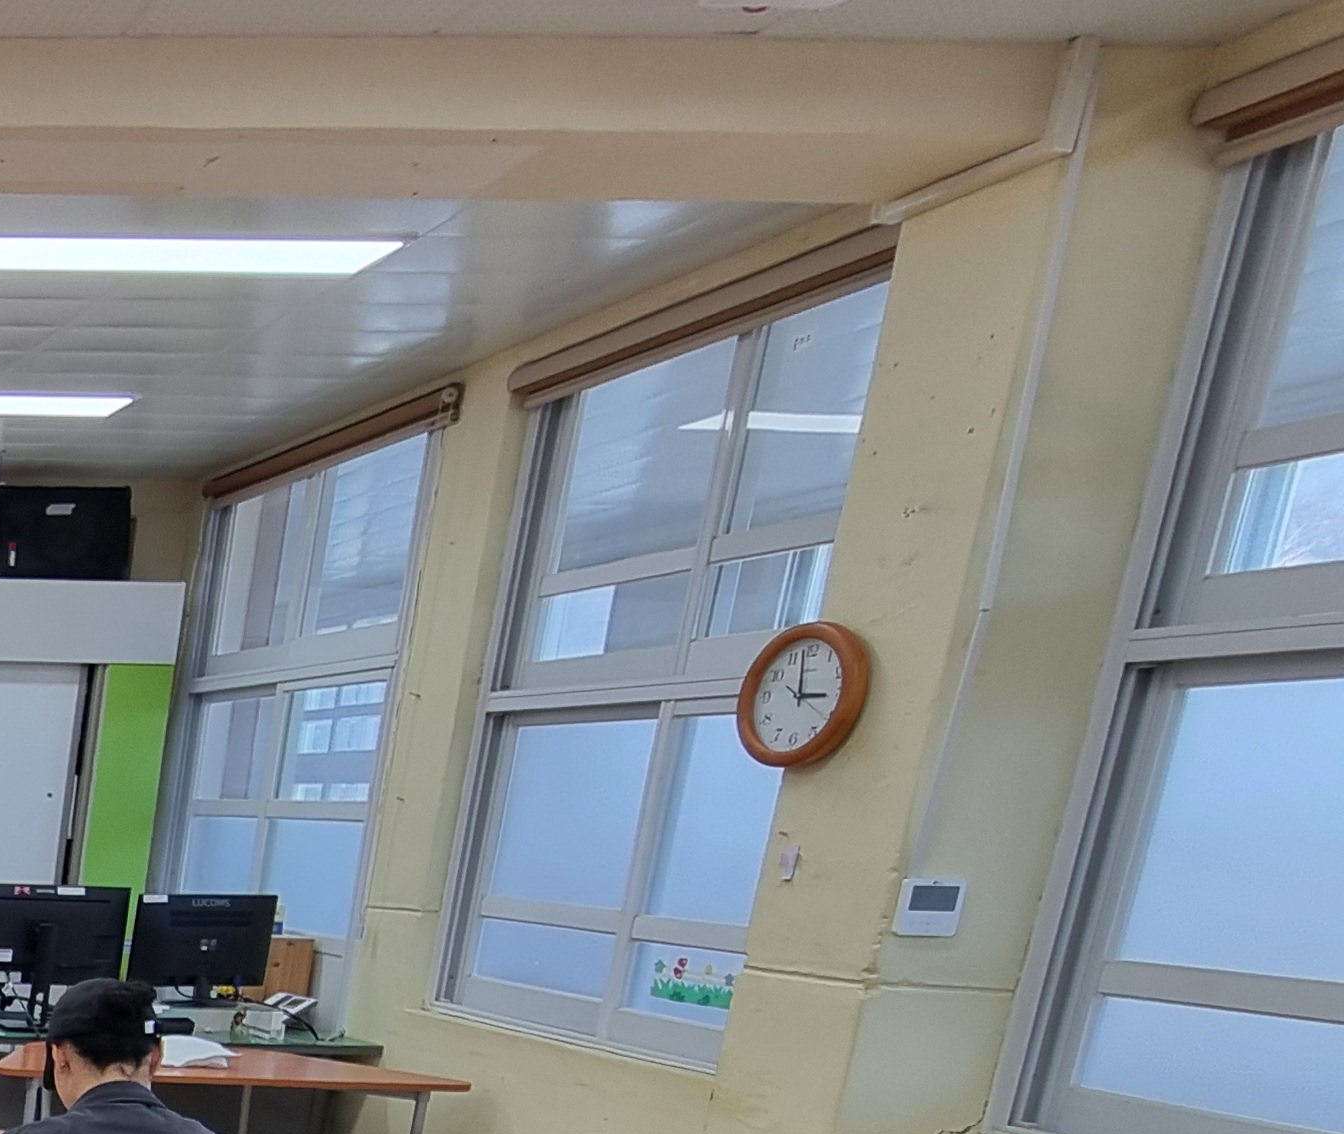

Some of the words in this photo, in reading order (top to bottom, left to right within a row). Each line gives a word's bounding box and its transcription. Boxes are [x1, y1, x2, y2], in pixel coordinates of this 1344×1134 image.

[806, 643, 820, 658] 12
[788, 652, 799, 666] 11
[770, 669, 785, 683] 10
[770, 727, 783, 743] 7
[788, 732, 799, 746] 6
